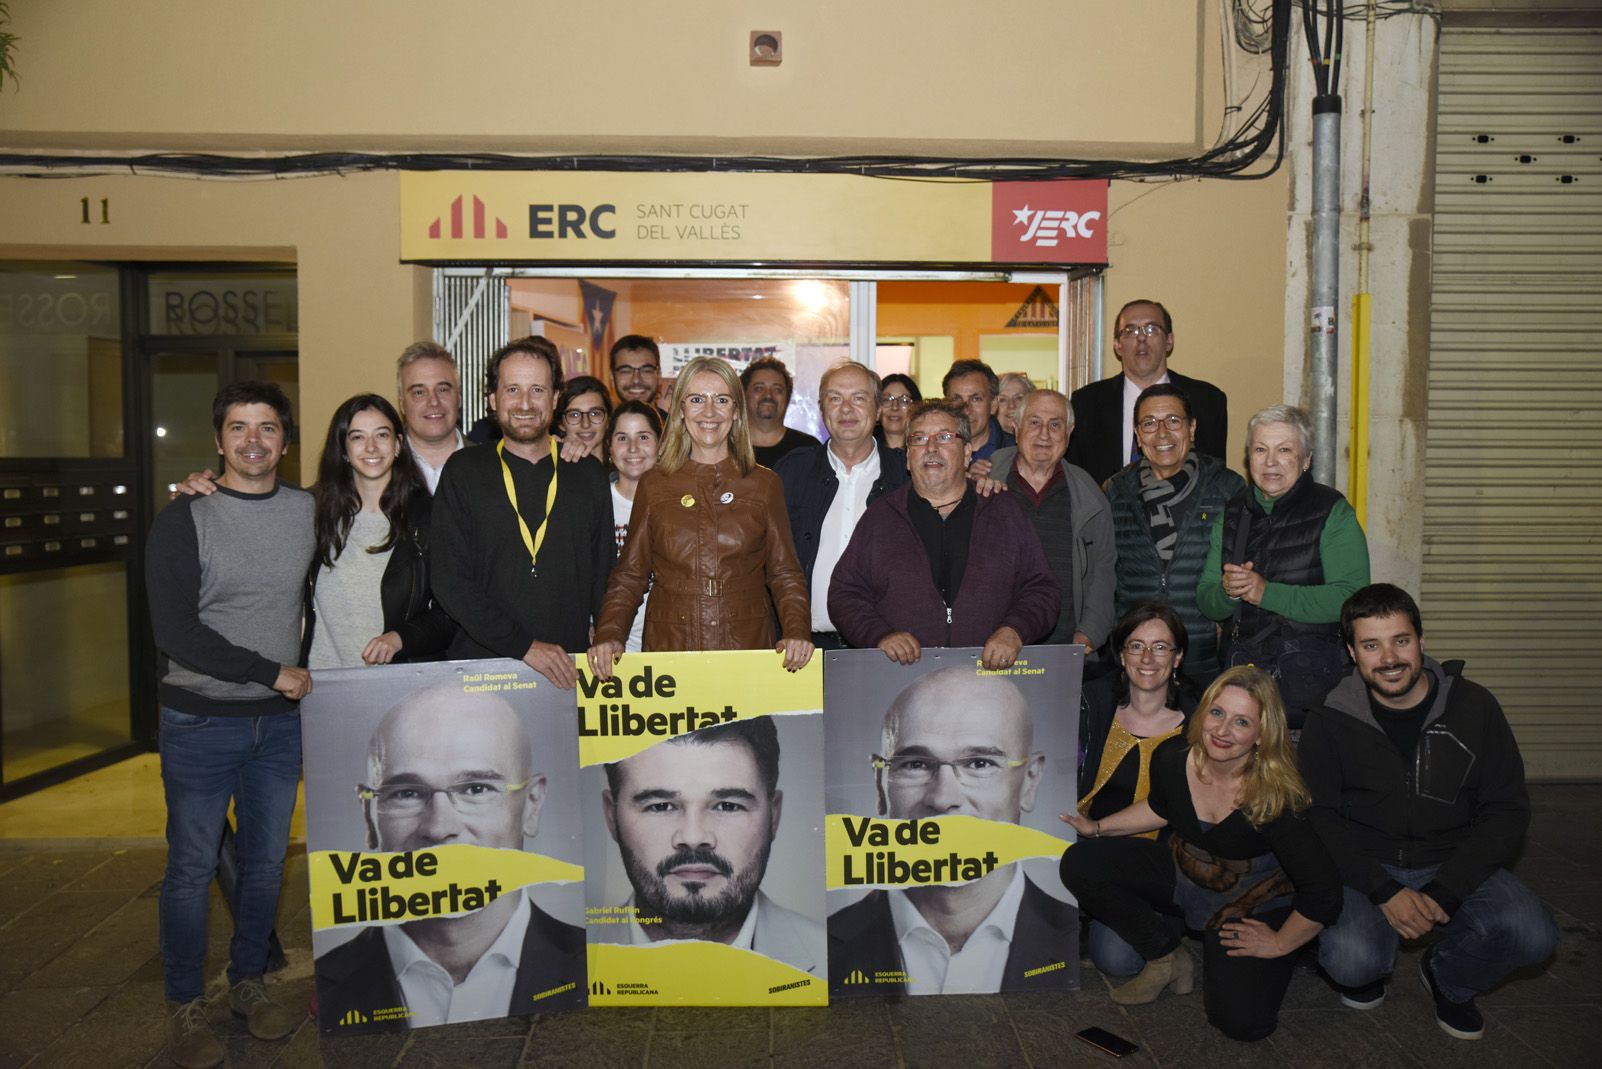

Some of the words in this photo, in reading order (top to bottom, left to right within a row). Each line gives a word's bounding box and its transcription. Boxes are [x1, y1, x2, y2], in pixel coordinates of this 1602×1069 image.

[80, 197, 110, 224] 11
[528, 203, 617, 240] ERC
[636, 203, 683, 220] SANT
[689, 203, 749, 220] CUGAT
[636, 224, 671, 240] DEL
[675, 223, 741, 240] VALLÈS
[1019, 210, 1101, 247] JERC
[483, 673, 518, 681] Romeva
[576, 668, 623, 699] Va
[628, 665, 677, 698] de
[1022, 667, 1045, 675] Senat
[463, 683, 501, 693] Candidat
[503, 682, 511, 691] al
[512, 680, 537, 689] Senat
[577, 703, 738, 737] Llibertat
[842, 817, 889, 847] Va
[895, 819, 941, 845] de
[328, 851, 382, 884] Va
[388, 851, 438, 879] de
[843, 851, 999, 885] Llibertat
[332, 879, 502, 924] Llibertat
[620, 916, 629, 924] al
[768, 979, 811, 994] SOBIRANISTES
